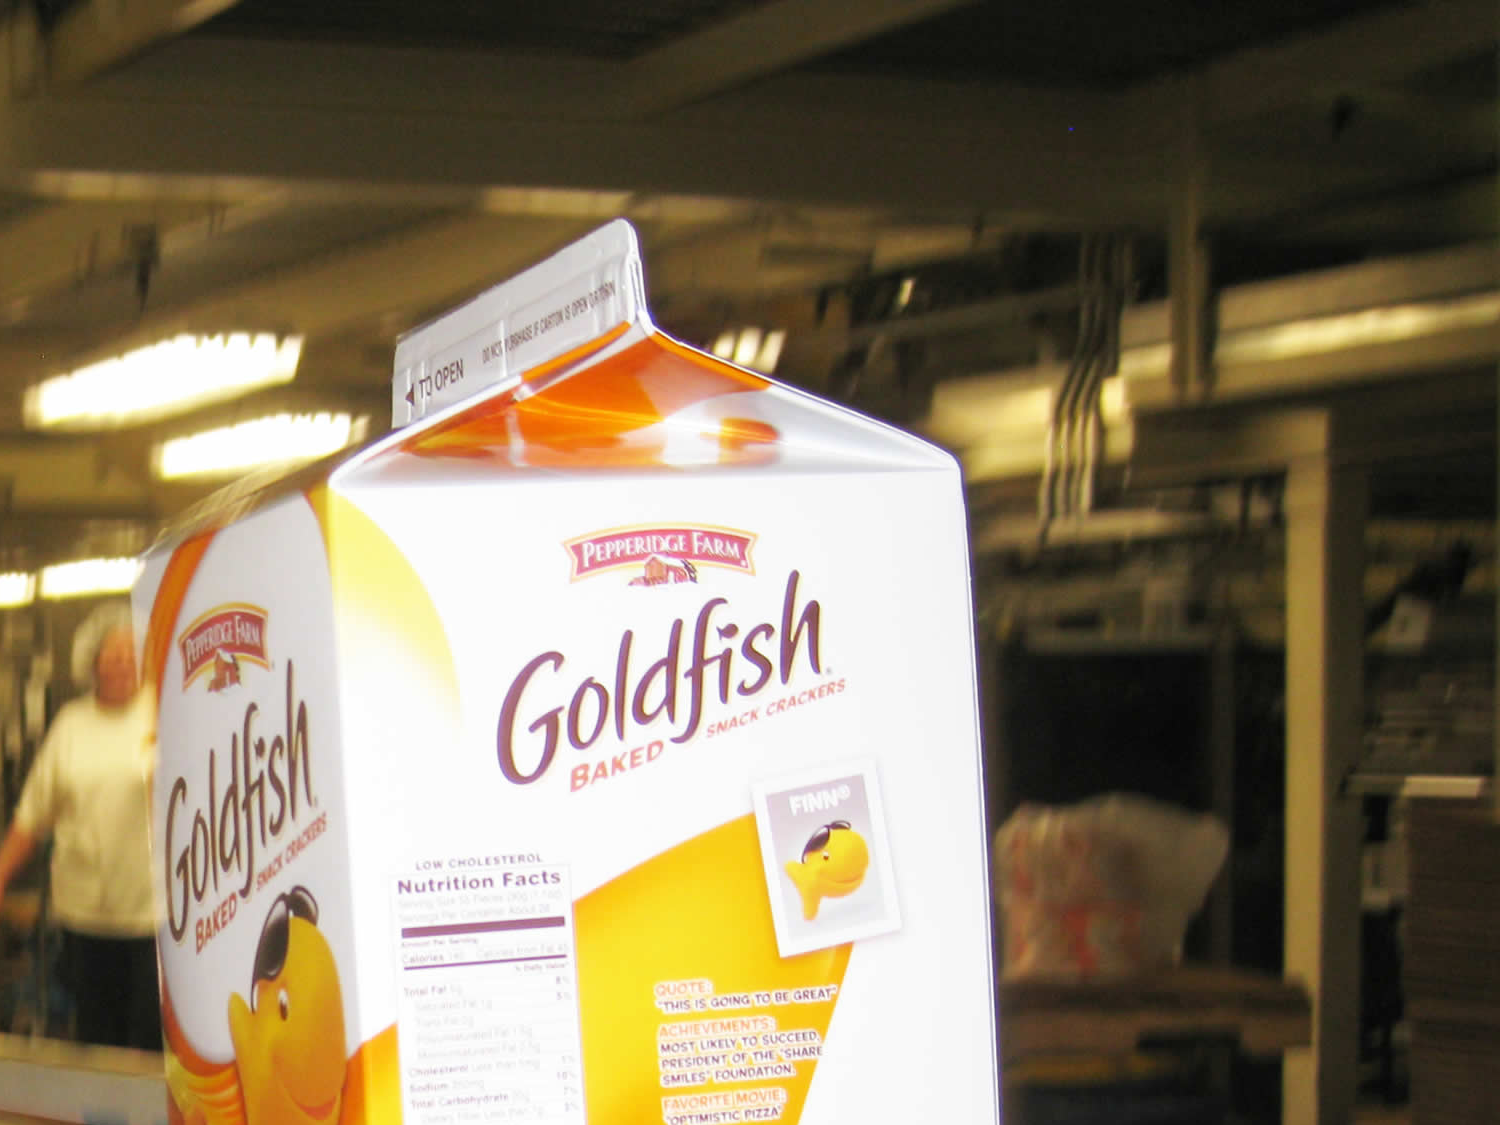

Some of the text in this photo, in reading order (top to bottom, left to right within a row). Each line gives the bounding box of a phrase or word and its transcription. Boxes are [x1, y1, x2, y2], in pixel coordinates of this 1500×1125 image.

[419, 358, 464, 399] TO OPEN
[581, 531, 742, 567] PEPPERIDGE FARM
[186, 615, 261, 670] PEPPERIDGE FARM
[497, 570, 820, 785] Goldfish
[706, 678, 846, 738] SNACK CRACKERS
[570, 741, 664, 793] BAKED
[165, 658, 312, 942] Goldfish
[257, 810, 327, 891] SNACK CRACKERS
[415, 853, 543, 872] LOW CHOLESTEROL
[397, 869, 561, 895] Nutrition Facts
[196, 892, 237, 955] BAKED
[402, 952, 444, 966] Calories
[404, 986, 429, 999] Total
[431, 984, 447, 996] Fat
[656, 981, 711, 997] QUOTE:
[695, 998, 706, 1009] IS
[711, 994, 750, 1007] GOING
[755, 993, 771, 1003] TO
[775, 990, 789, 1002] BE
[793, 985, 837, 1001] GREAT"
[659, 1018, 773, 1037] ACHIEVEMENTS:
[660, 1041, 695, 1054] MOST
[700, 1039, 737, 1050] LIKELY
[741, 1035, 758, 1047] TO
[661, 1055, 728, 1069] PRESIDENT
[731, 1053, 747, 1064] OF
[753, 1050, 775, 1061] THE
[408, 1063, 468, 1079] Cholesterol
[410, 1081, 449, 1094] Sodium
[411, 1098, 436, 1111] Total
[438, 1093, 509, 1108] Carbohydrate
[663, 1095, 732, 1110] FAVORITE
